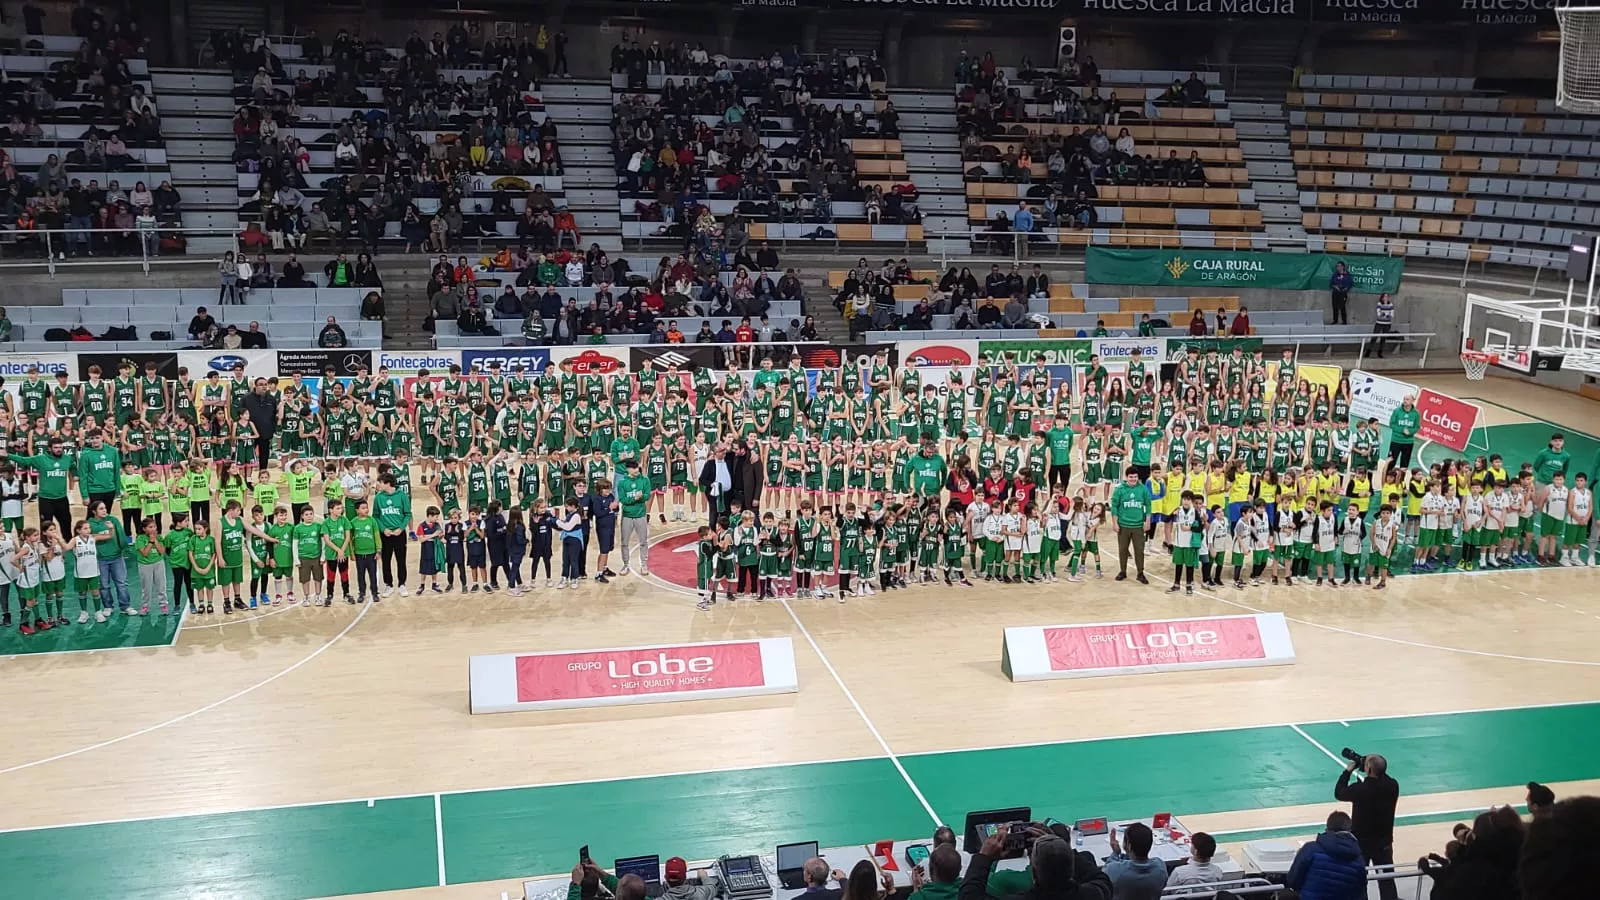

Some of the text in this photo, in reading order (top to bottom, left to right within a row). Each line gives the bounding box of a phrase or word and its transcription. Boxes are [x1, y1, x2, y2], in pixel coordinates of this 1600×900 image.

[1193, 260, 1265, 271] CAJA RURAL
[1366, 266, 1385, 276] San
[1201, 271, 1257, 281] DE ARAGÓN
[381, 354, 453, 369] Fontecabras
[565, 391, 574, 400] 57
[121, 397, 133, 407] 34
[150, 397, 156, 405] 6
[379, 397, 390, 406] 34
[953, 409, 962, 419] 22
[817, 416, 822, 425] 3
[924, 416, 934, 425] 99
[1423, 409, 1462, 432] Lobe
[286, 421, 298, 430] 59
[334, 432, 341, 441] 11
[160, 442, 166, 450] 2
[1239, 451, 1249, 459] 27
[94, 460, 114, 471] PEÑAS
[652, 465, 663, 474] 23
[676, 462, 684, 471] 13
[772, 462, 778, 471] 3
[896, 465, 903, 475] 11
[919, 468, 937, 478] PEÑAS
[473, 481, 485, 491] 34
[555, 479, 561, 487] 7
[1123, 500, 1143, 509] PEÑAS
[909, 526, 918, 535] 17
[745, 546, 751, 555] 6
[823, 543, 832, 552] 88
[953, 543, 957, 552] 1
[1089, 626, 1219, 650] GRUPO Lobe
[567, 653, 714, 679] GRUPO Lobe
[621, 677, 706, 689] HIGH QUALITY HOMES
